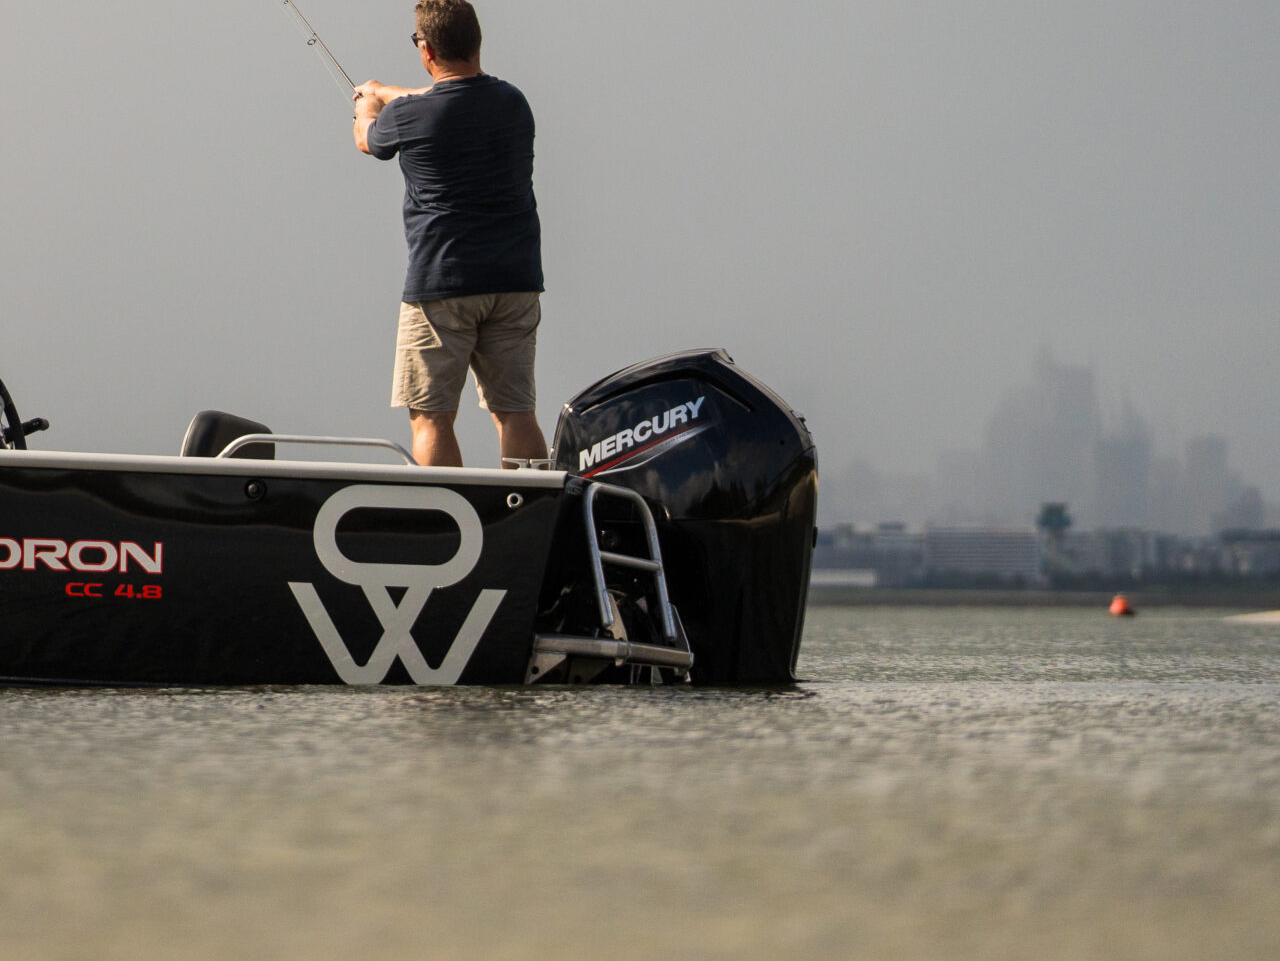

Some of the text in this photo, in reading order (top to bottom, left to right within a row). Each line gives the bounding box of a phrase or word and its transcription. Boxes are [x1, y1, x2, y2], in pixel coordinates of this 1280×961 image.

[578, 396, 705, 471] MERCURY
[65, 582, 162, 599] CC 4.8
